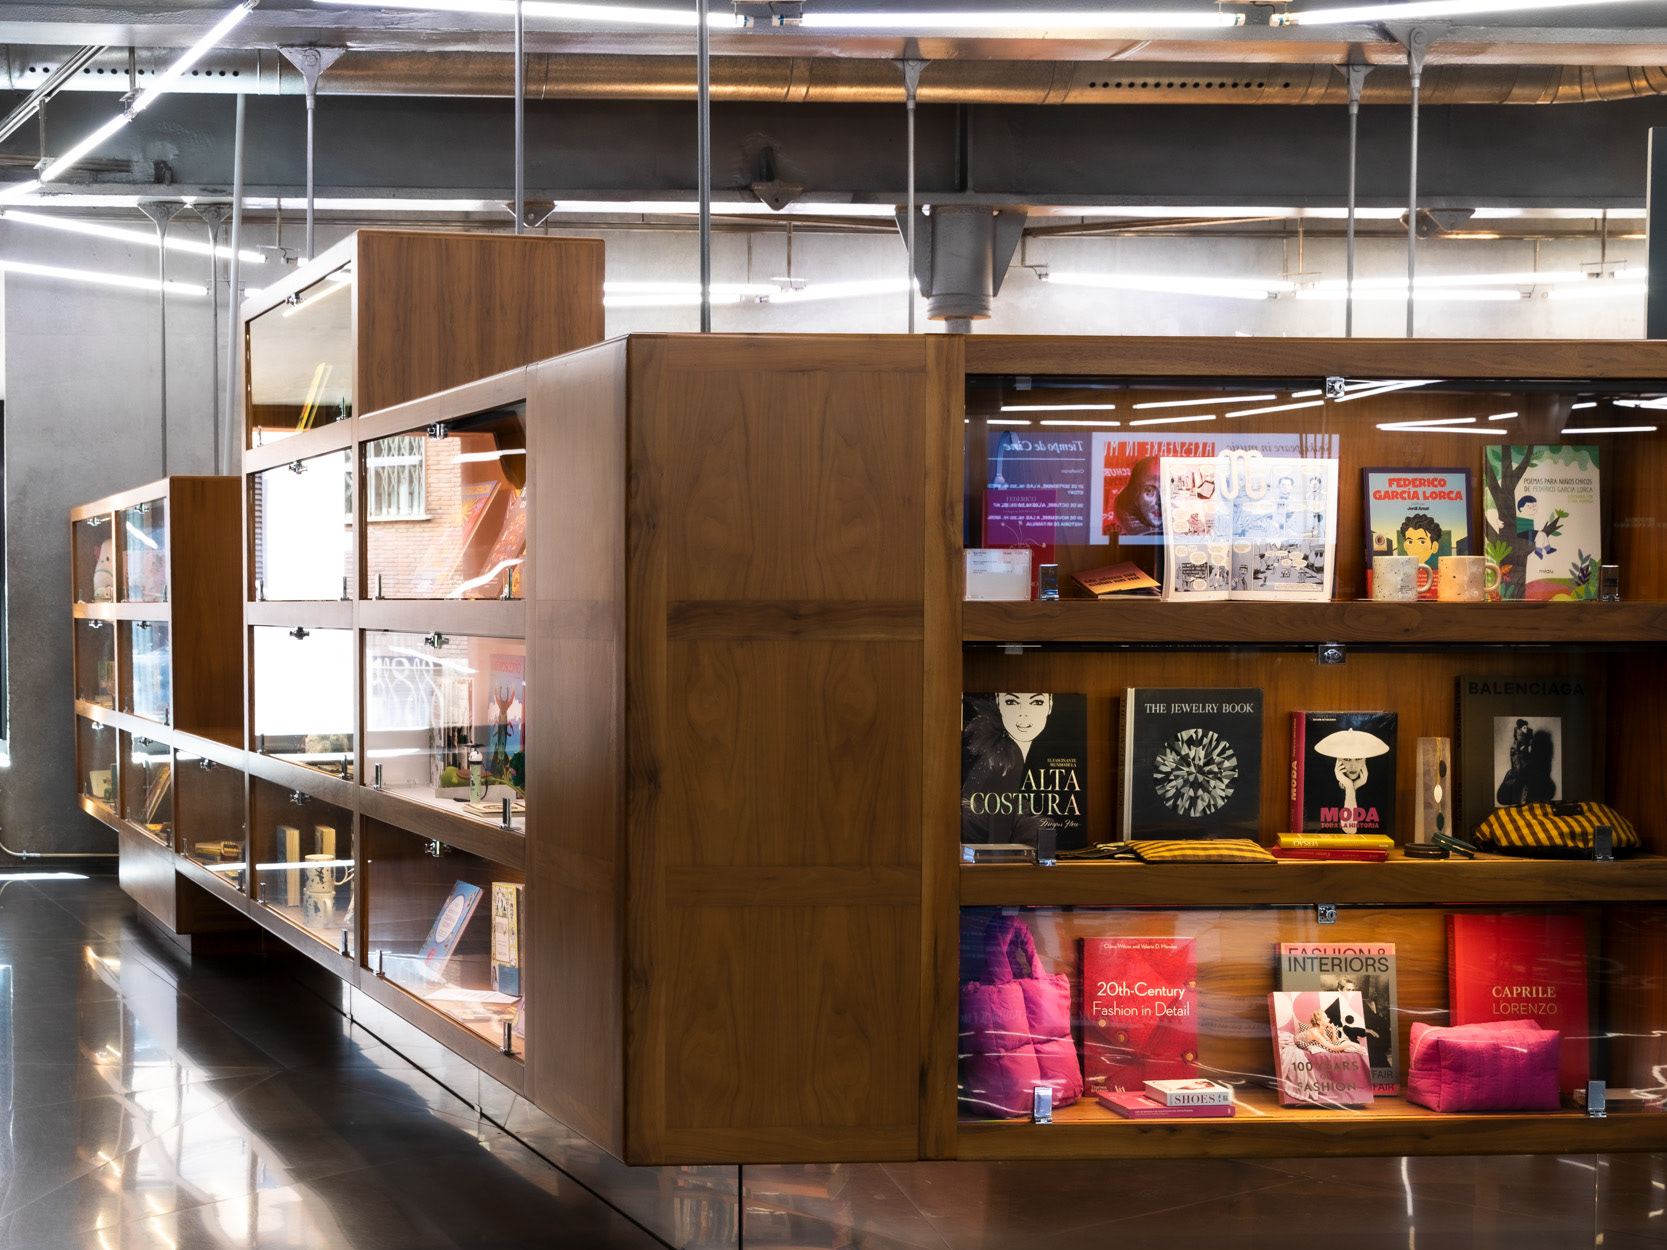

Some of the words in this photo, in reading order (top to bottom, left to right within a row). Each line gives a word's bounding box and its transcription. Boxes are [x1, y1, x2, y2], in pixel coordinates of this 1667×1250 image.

[1388, 478, 1447, 488] FEDERICO
[1373, 488, 1420, 500] GARCÍA
[1422, 490, 1463, 500] LORCA
[1469, 682, 1584, 696] BALENCIAGA
[1144, 704, 1166, 713] THE
[1171, 704, 1219, 714] JEWELRY
[1222, 703, 1254, 713] BOOK
[1021, 769, 1081, 791] ALTA
[970, 792, 1081, 816] COSTURA
[1320, 807, 1380, 822] MODA
[1288, 957, 1389, 972] INTERIORS
[1097, 981, 1185, 1000] 20th-Century
[1492, 986, 1556, 998] CAPRILE
[1093, 1001, 1138, 1016] Fashion
[1142, 1005, 1151, 1016] in
[1155, 1001, 1190, 1016] Detail
[1493, 1003, 1557, 1014] LORENZO
[1292, 1062, 1313, 1071] 100
[1316, 1061, 1359, 1071] YEARS
[1298, 1082, 1356, 1092] FASHION
[1175, 1094, 1215, 1104] SHOES
